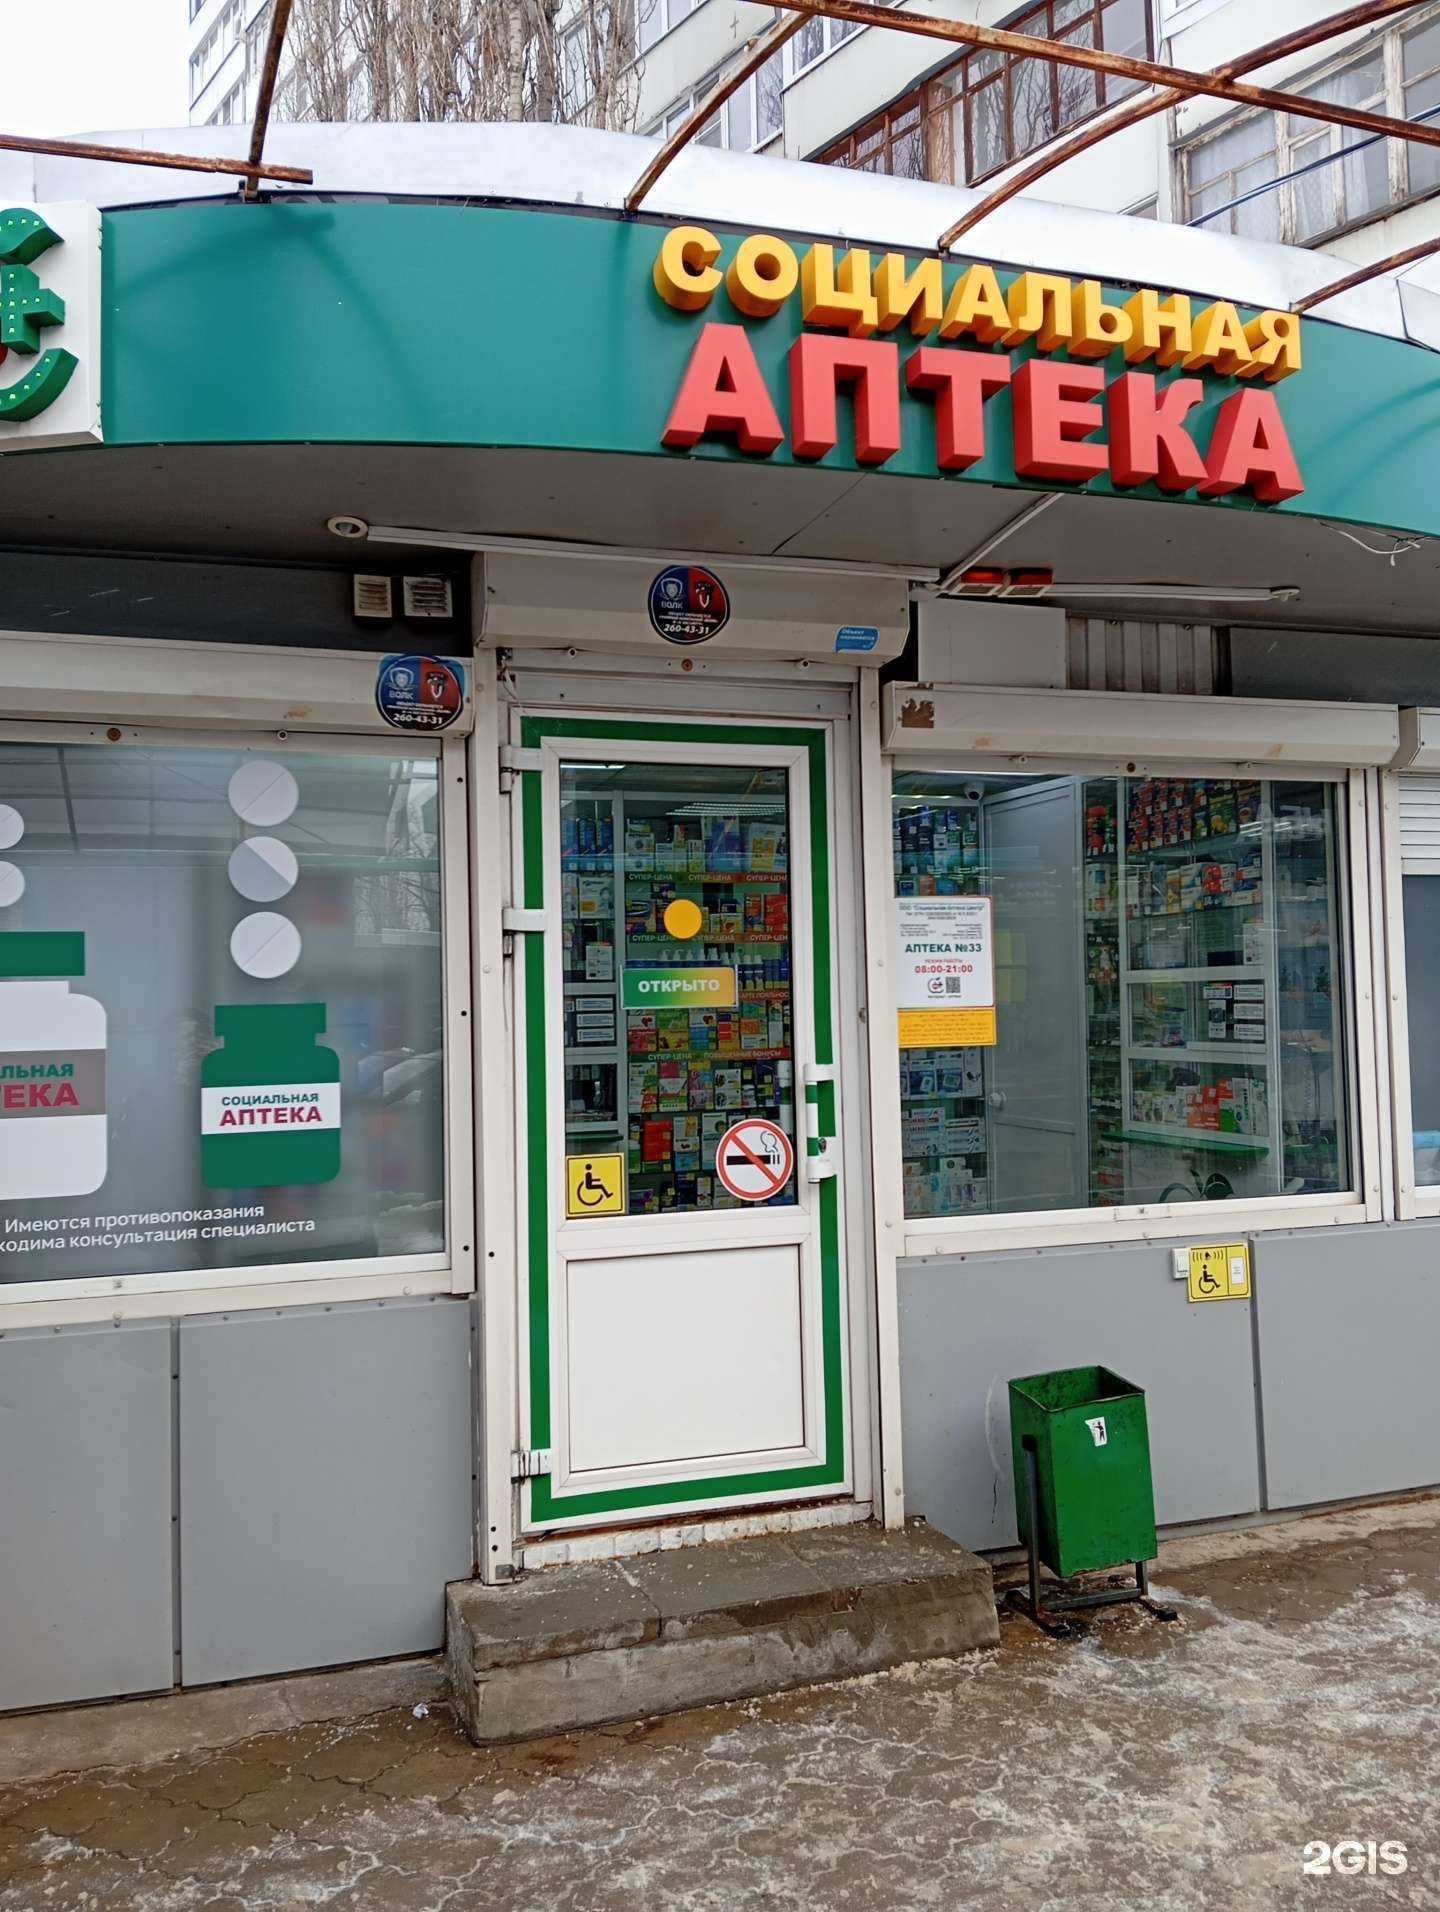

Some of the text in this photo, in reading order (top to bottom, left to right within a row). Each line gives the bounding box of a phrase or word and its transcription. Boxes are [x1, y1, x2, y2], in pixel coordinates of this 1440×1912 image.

[653, 225, 1303, 383] СОЦИАЛЬНАЯ
[659, 322, 1305, 504] АПТЕКА
[663, 623, 711, 634] 260-43-31
[393, 713, 443, 725] 260-43-31
[750, 934, 788, 943] СУПЕР-ЦЕН
[904, 943, 982, 953] АПТЕКА №33
[914, 964, 973, 974] 08:00-21:00
[638, 979, 720, 993] ОТКРЫТО
[0, 1082, 80, 1108] ЕКА
[221, 1092, 319, 1107] СОЦИАЛЬНАЯ
[218, 1105, 323, 1127] АПТЕКА
[4, 1205, 266, 1234] Имеются противопоказания
[69, 1227, 198, 1249] консультация
[200, 1218, 316, 1239] специалиста
